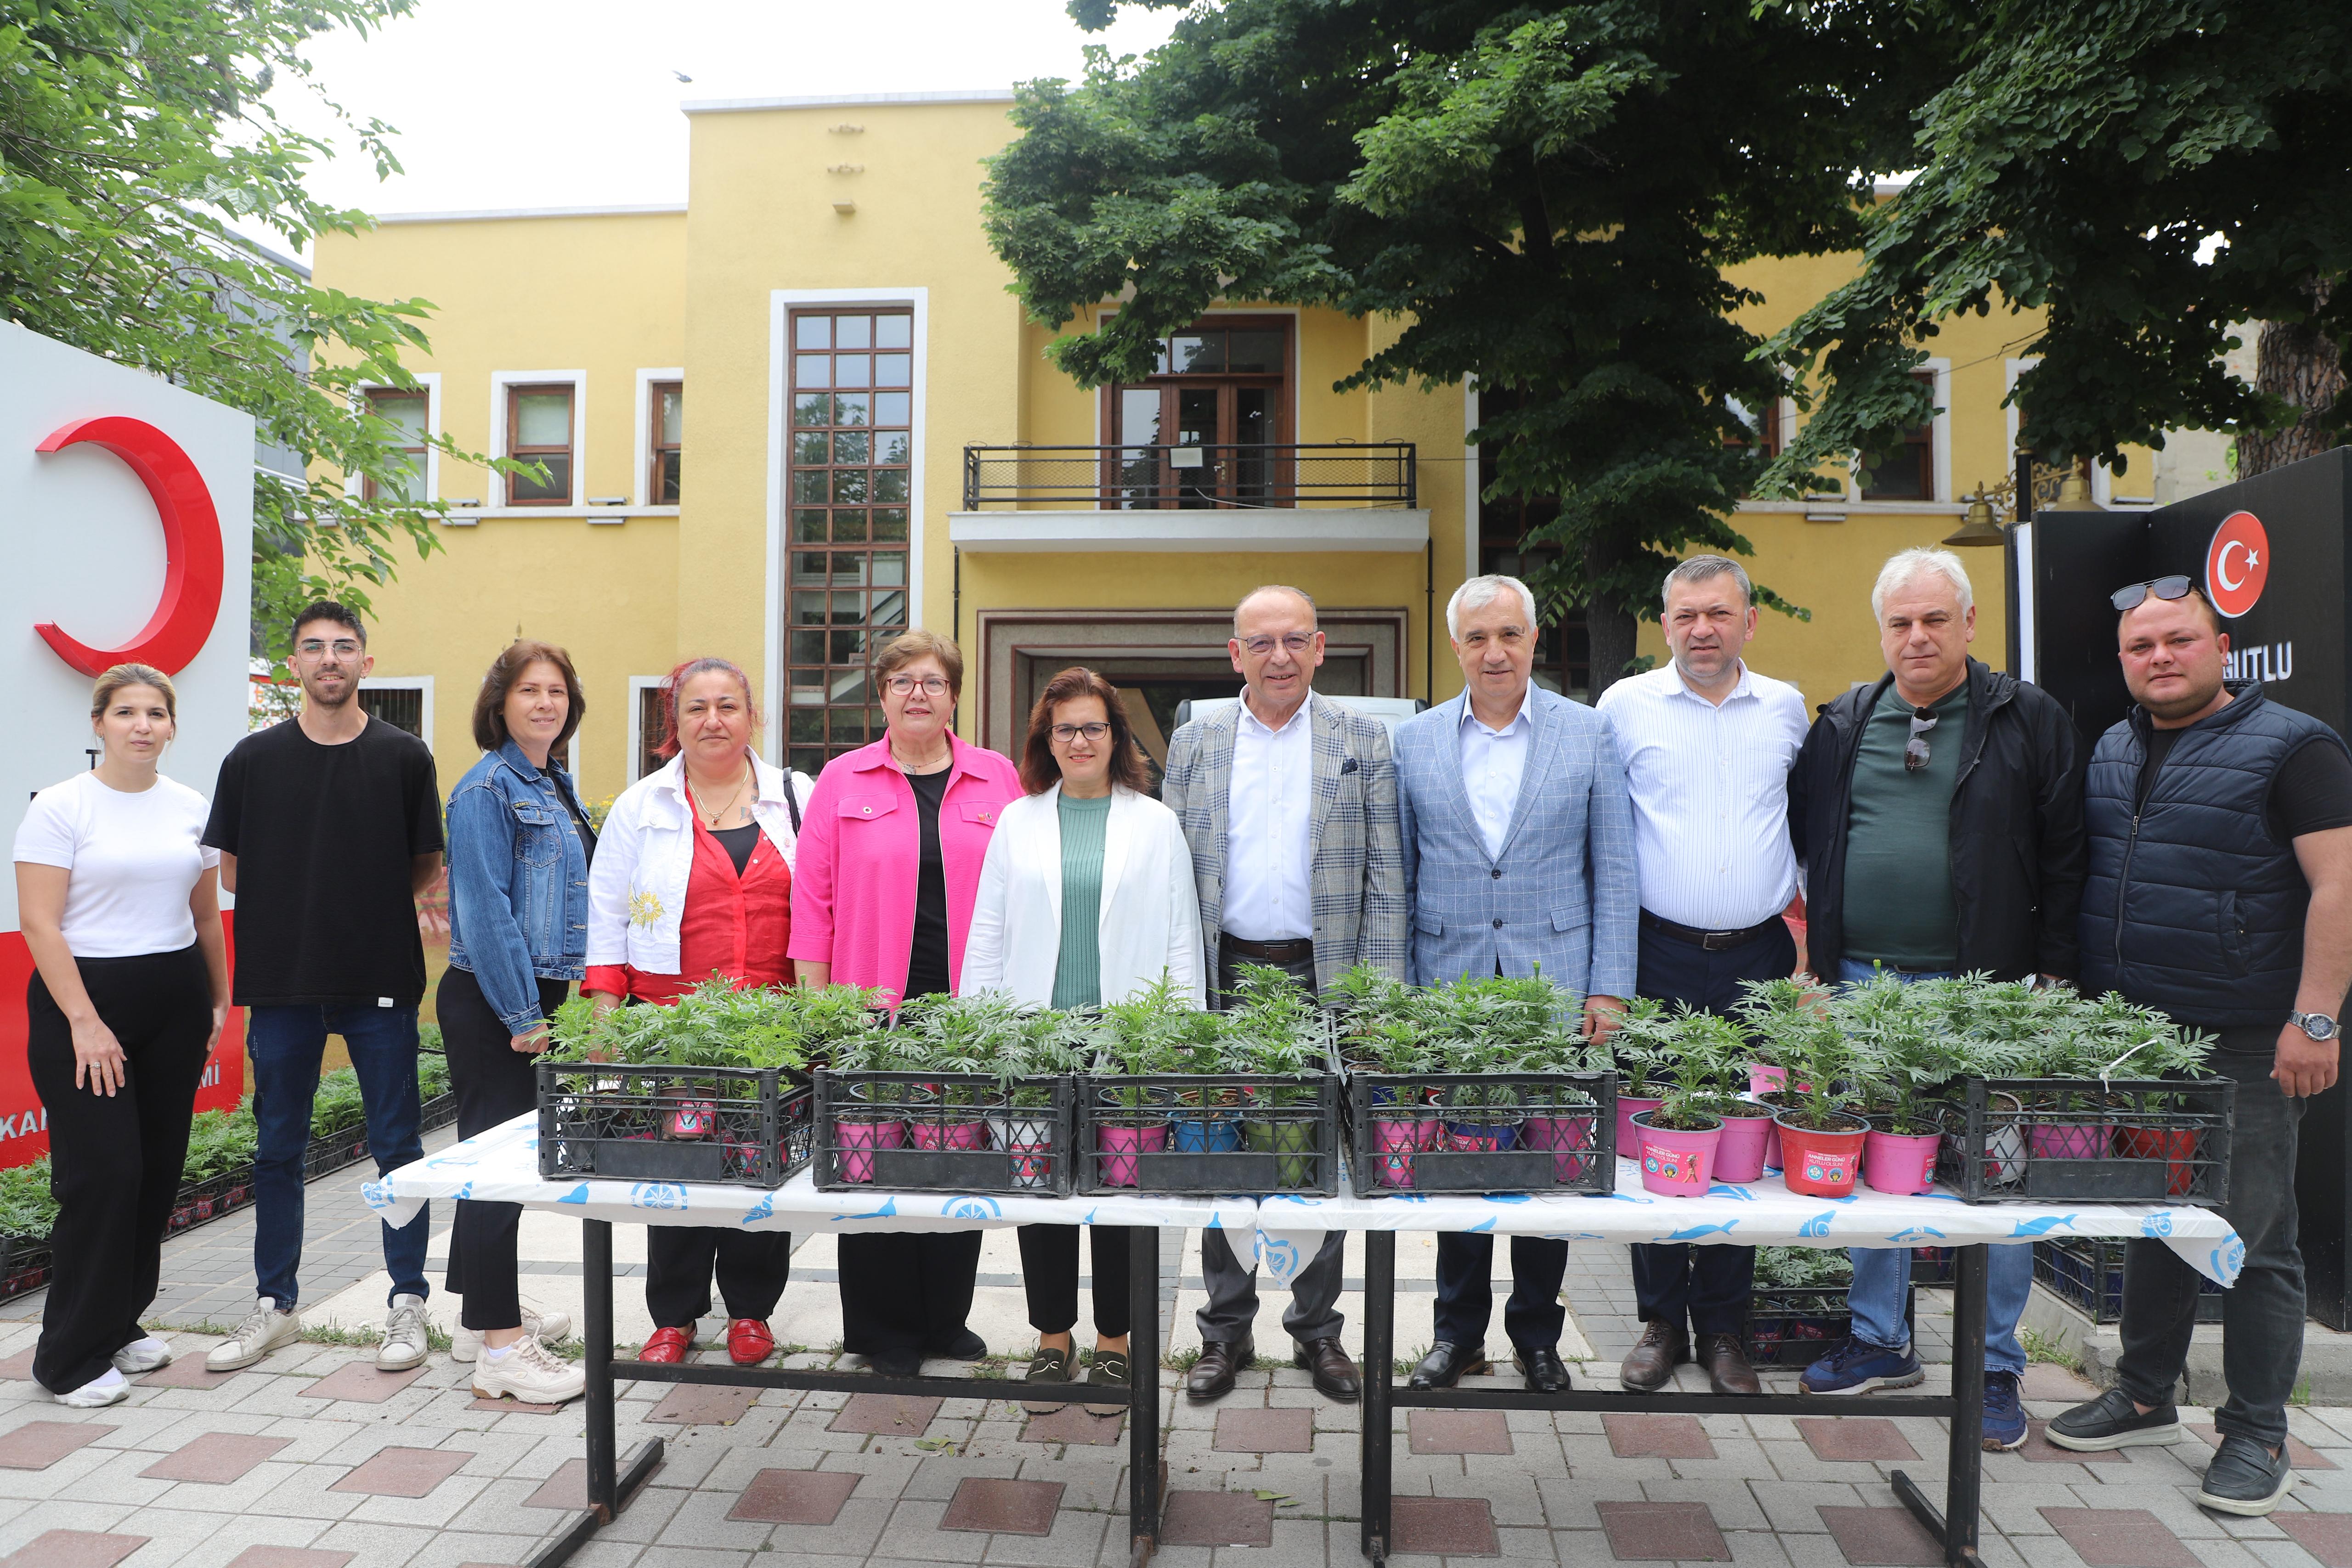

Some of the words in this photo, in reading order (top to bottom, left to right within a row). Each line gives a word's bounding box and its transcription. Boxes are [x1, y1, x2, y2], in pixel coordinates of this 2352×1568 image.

[1645, 1145, 1666, 1156] ANNELER
[1646, 1150, 1660, 1158] KUTLU
[1660, 1155, 1678, 1163] OLSUN!
